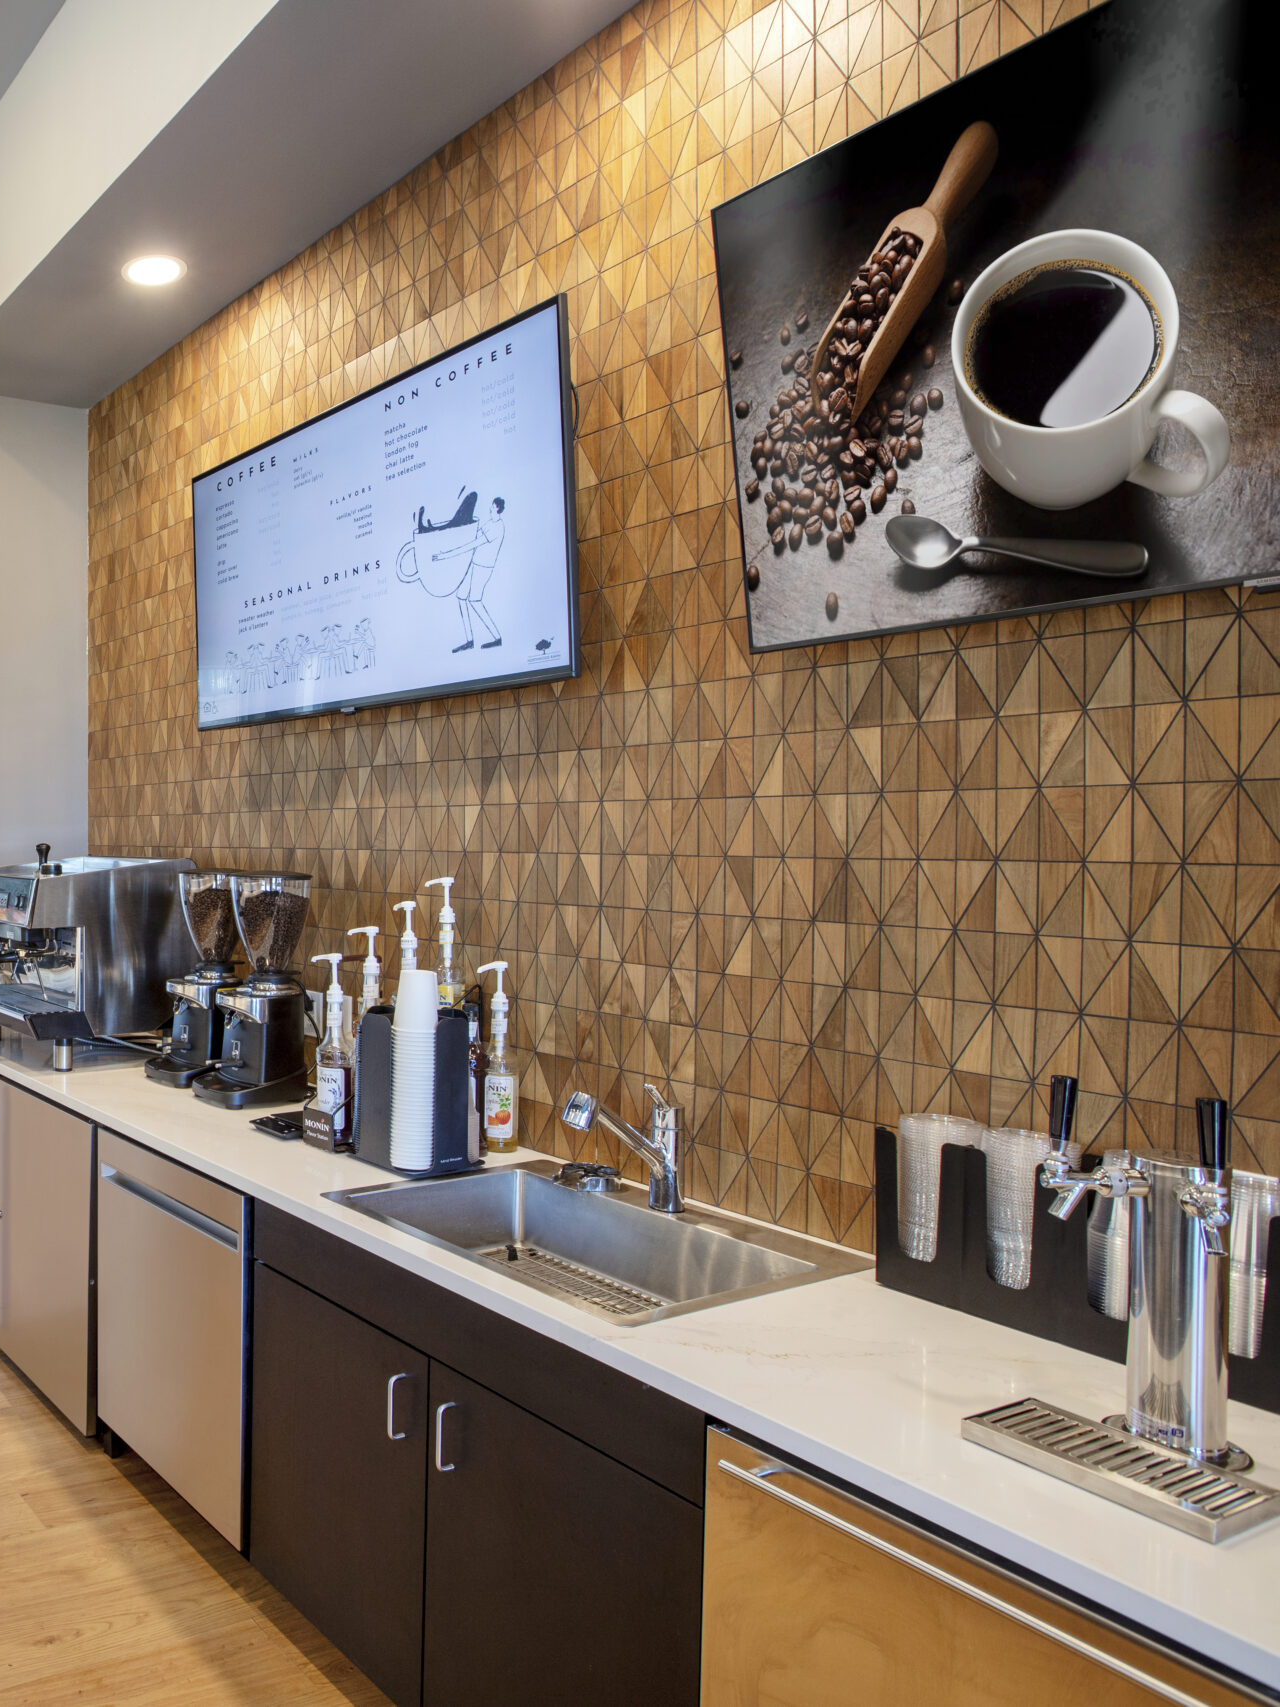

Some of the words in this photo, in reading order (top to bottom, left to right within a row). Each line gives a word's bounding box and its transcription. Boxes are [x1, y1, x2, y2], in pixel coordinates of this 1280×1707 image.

[384, 388, 418, 412] NON
[435, 343, 512, 388] COFFEE
[384, 422, 406, 436] matcha
[384, 438, 395, 448] hot
[396, 425, 428, 443] chocolate
[384, 446, 406, 459] london
[408, 440, 419, 449] fog
[385, 460, 398, 470] chai
[400, 454, 414, 464] latte
[385, 473, 396, 481] tea
[397, 461, 426, 477] selection
[217, 456, 276, 492] COFFEE
[330, 485, 372, 505] FLAVORS
[244, 582, 311, 608] SEASONAL
[323, 560, 380, 585] DRINKS
[305, 1118, 329, 1132] MONIN
